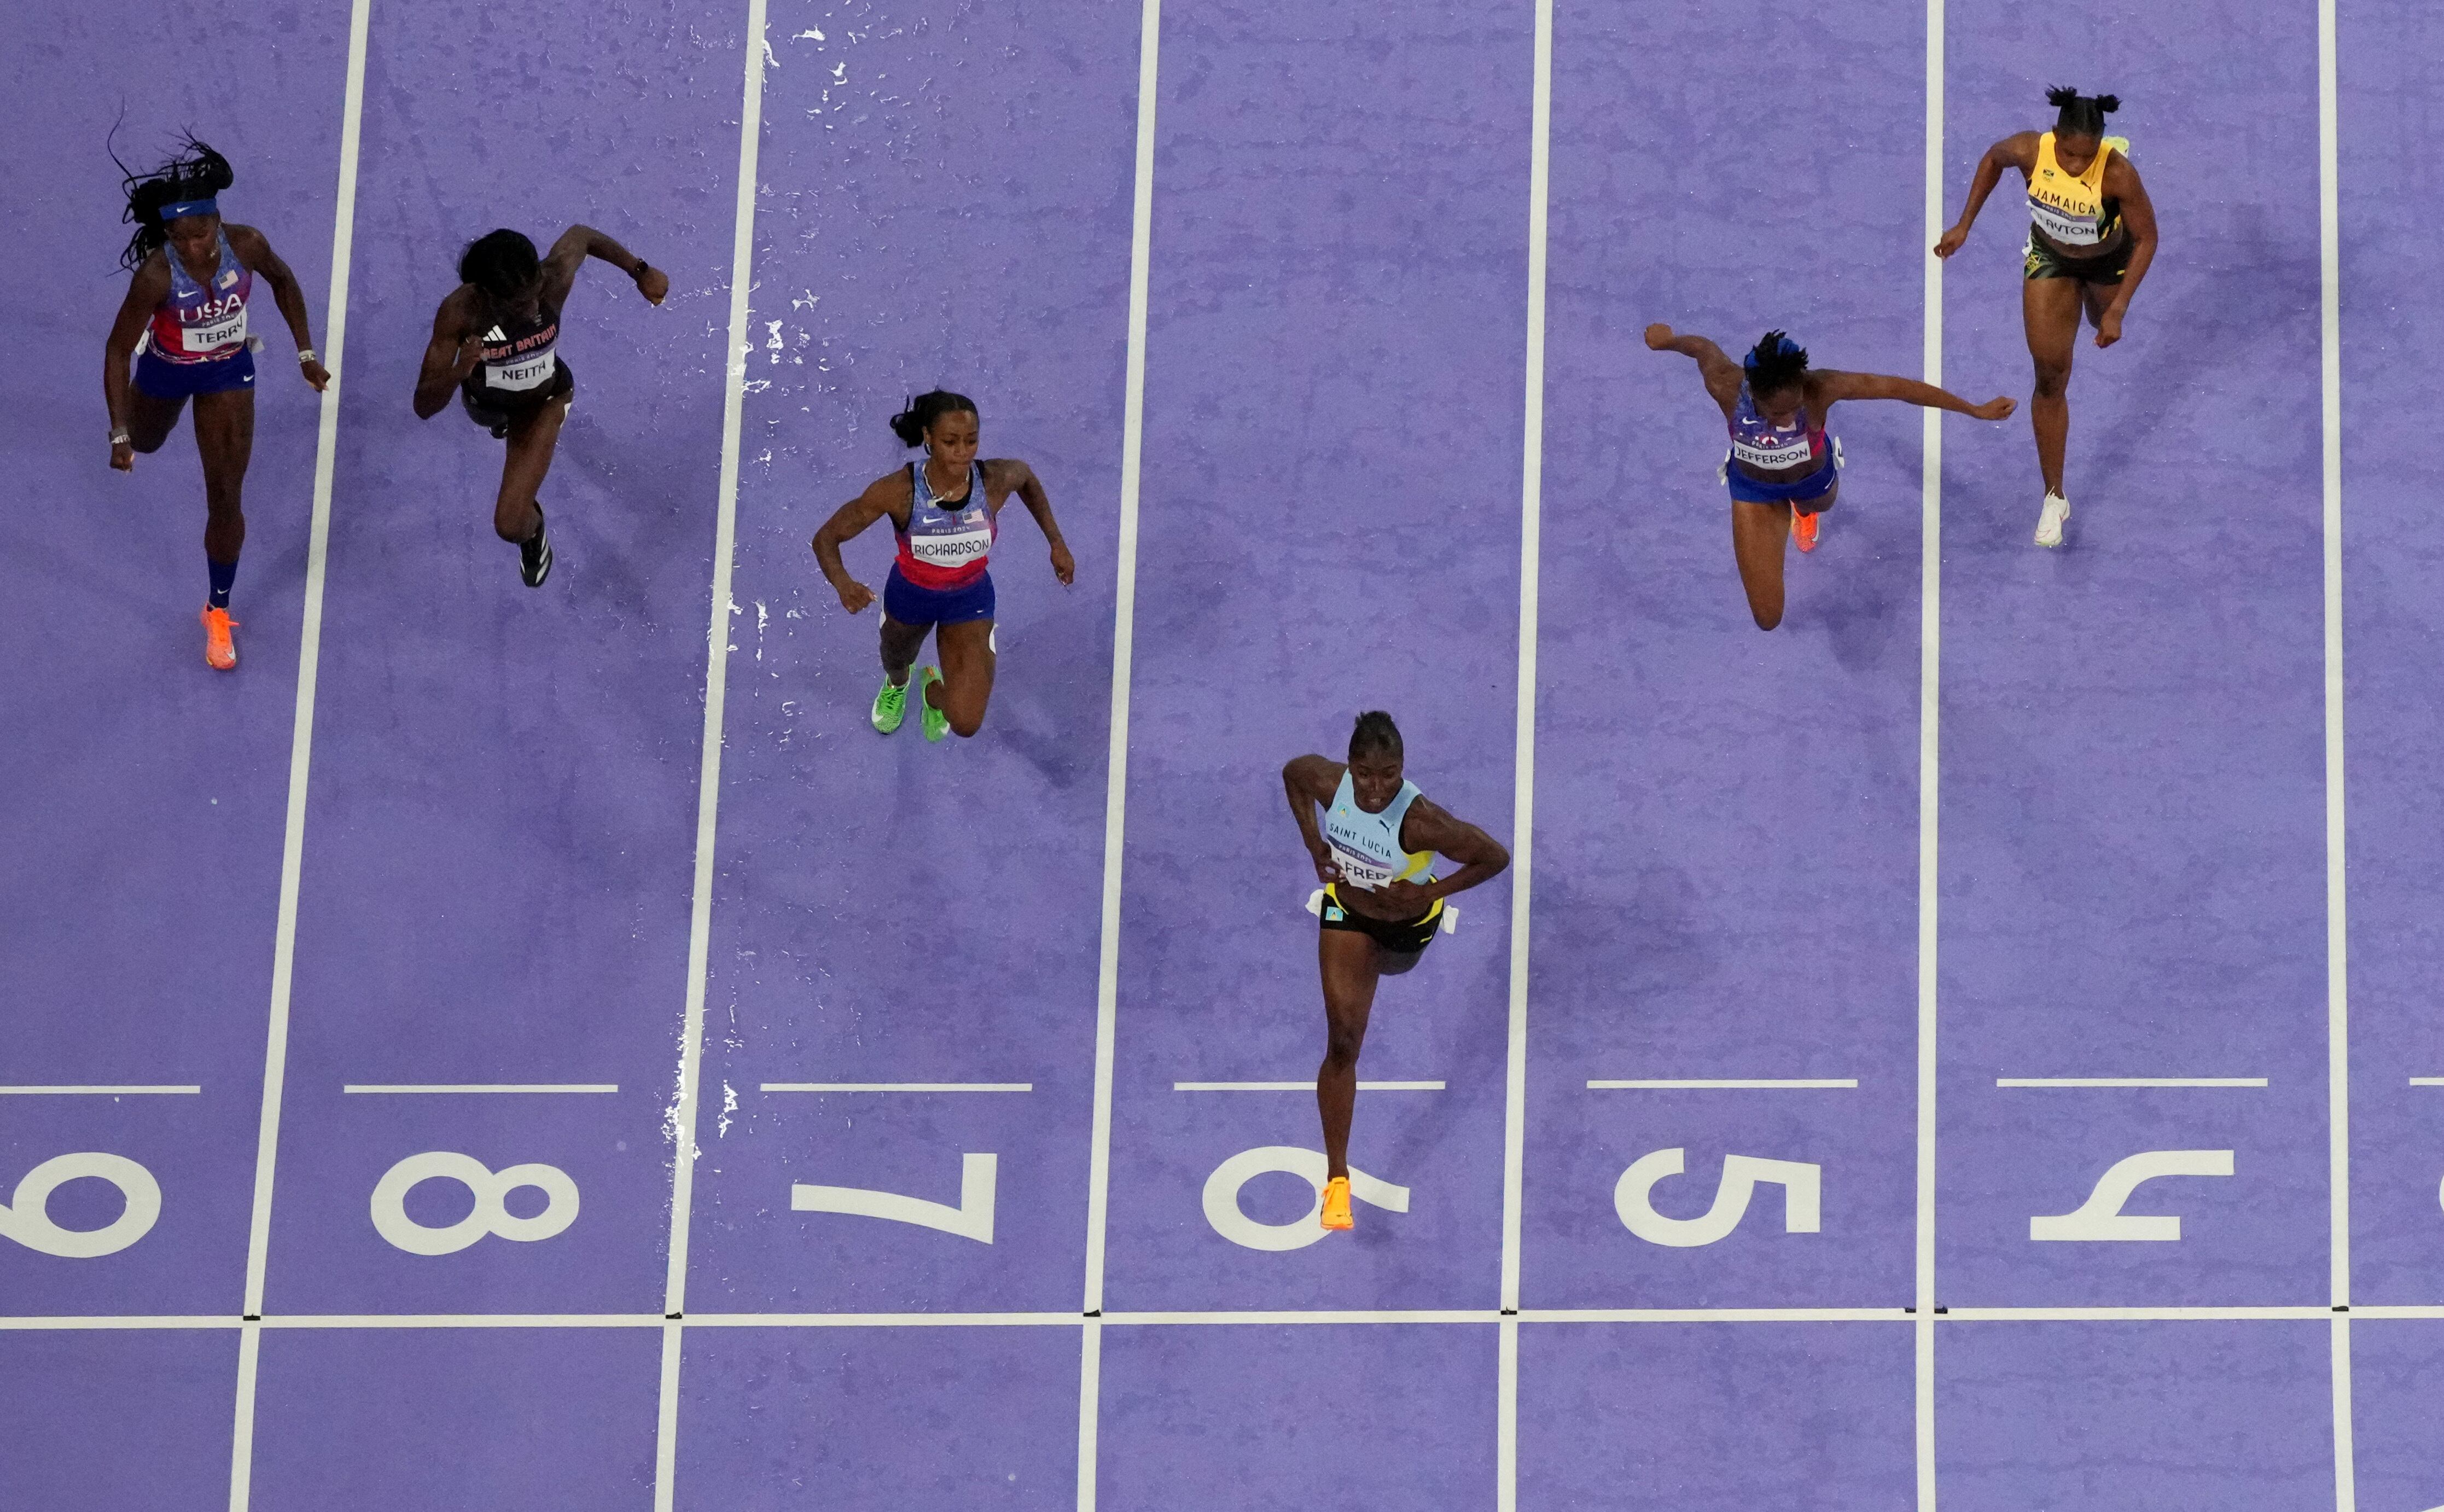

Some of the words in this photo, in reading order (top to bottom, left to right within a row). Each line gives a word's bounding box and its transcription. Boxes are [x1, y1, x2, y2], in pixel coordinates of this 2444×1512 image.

[2034, 187, 2096, 215] JAMAICA
[179, 294, 242, 322] USA
[195, 315, 242, 344] TERRY
[483, 344, 513, 359] REAT
[516, 323, 557, 352] BRITAIN
[502, 360, 546, 380] NEITH
[1737, 447, 1807, 464] JEFFERSON
[915, 538, 989, 556] RICHARDSON
[1329, 823, 1357, 840] SAINT
[1362, 836, 1392, 858] LUCIA
[1337, 857, 1388, 880] FRED
[0, 1153, 161, 1258] 9
[370, 1151, 580, 1256] 8
[792, 1153, 997, 1245] 7
[1202, 1145, 1410, 1252] 6
[1614, 1148, 1821, 1247] 5
[2030, 1149, 2234, 1241] 4
